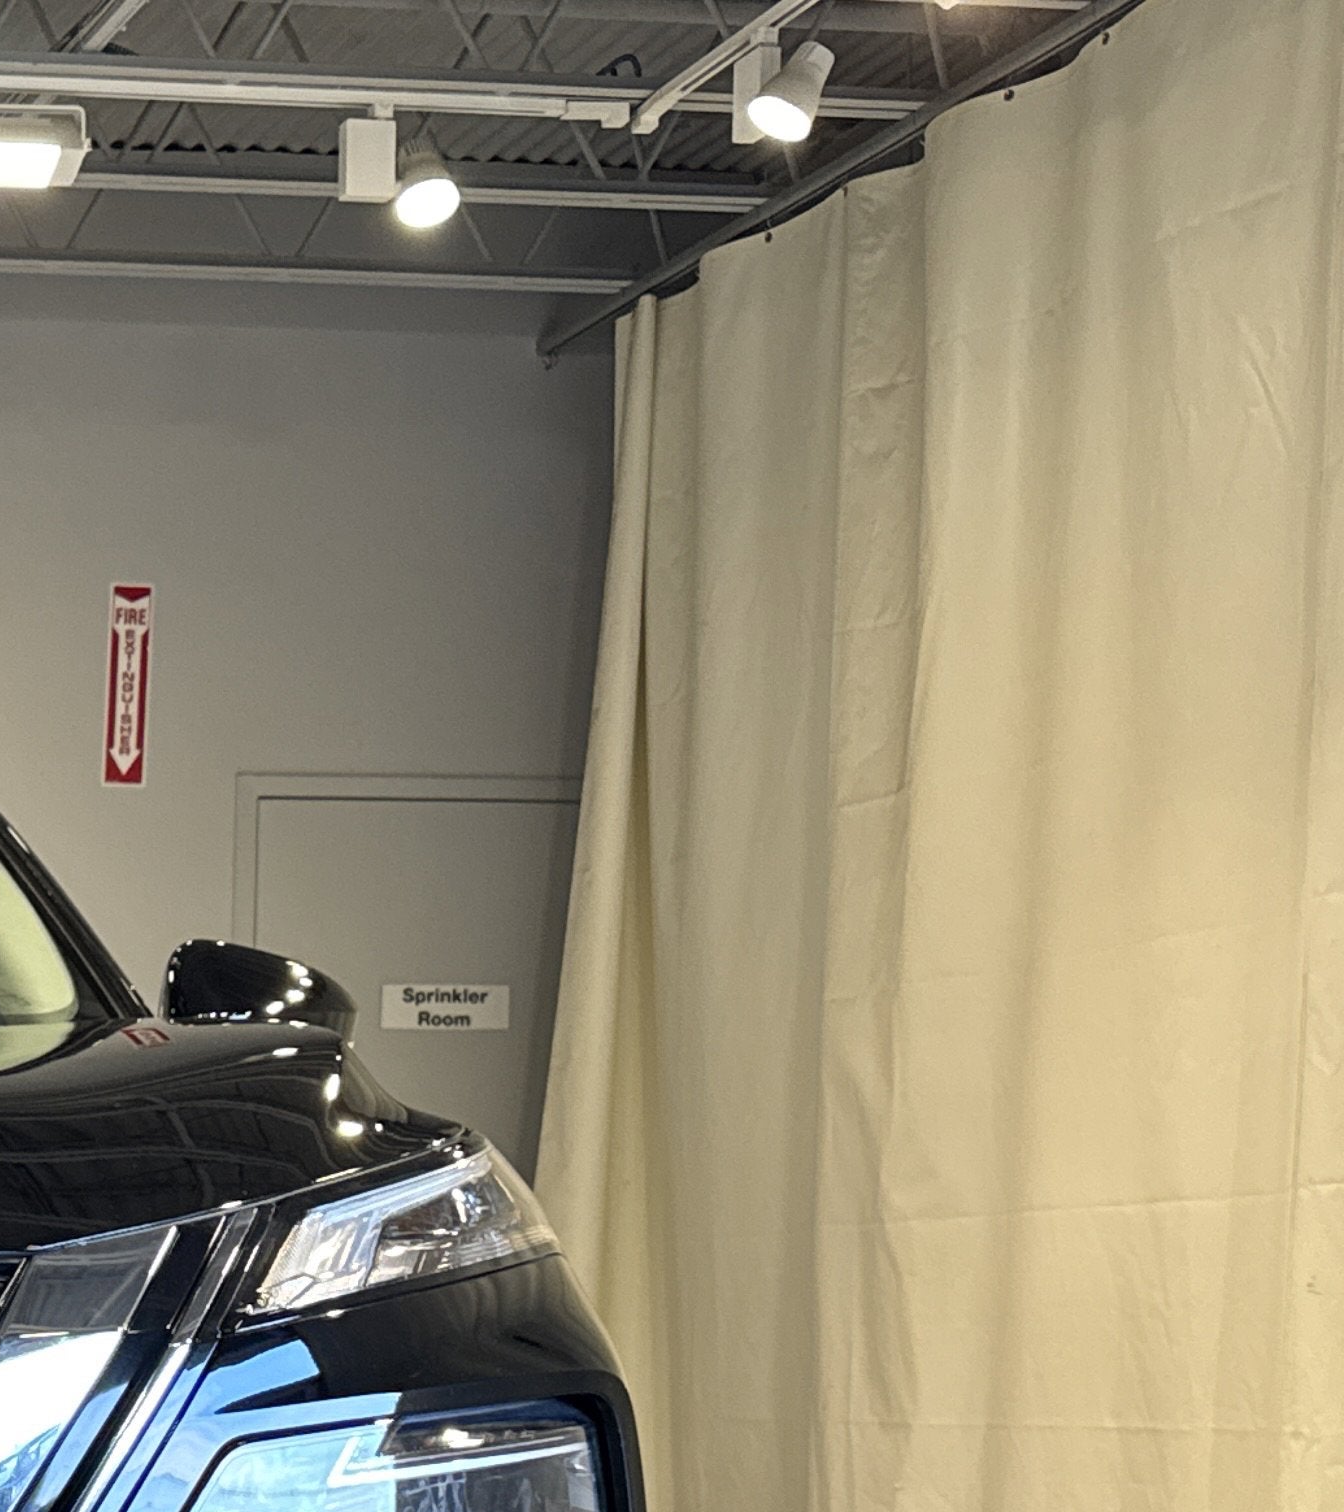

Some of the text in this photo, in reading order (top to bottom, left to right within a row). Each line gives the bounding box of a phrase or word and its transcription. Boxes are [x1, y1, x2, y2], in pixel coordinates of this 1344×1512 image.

[114, 607, 147, 626] FIRE
[118, 629, 136, 756] EXTINGUISHER
[402, 987, 488, 1006] Sprinkler
[417, 1011, 471, 1027] Room
